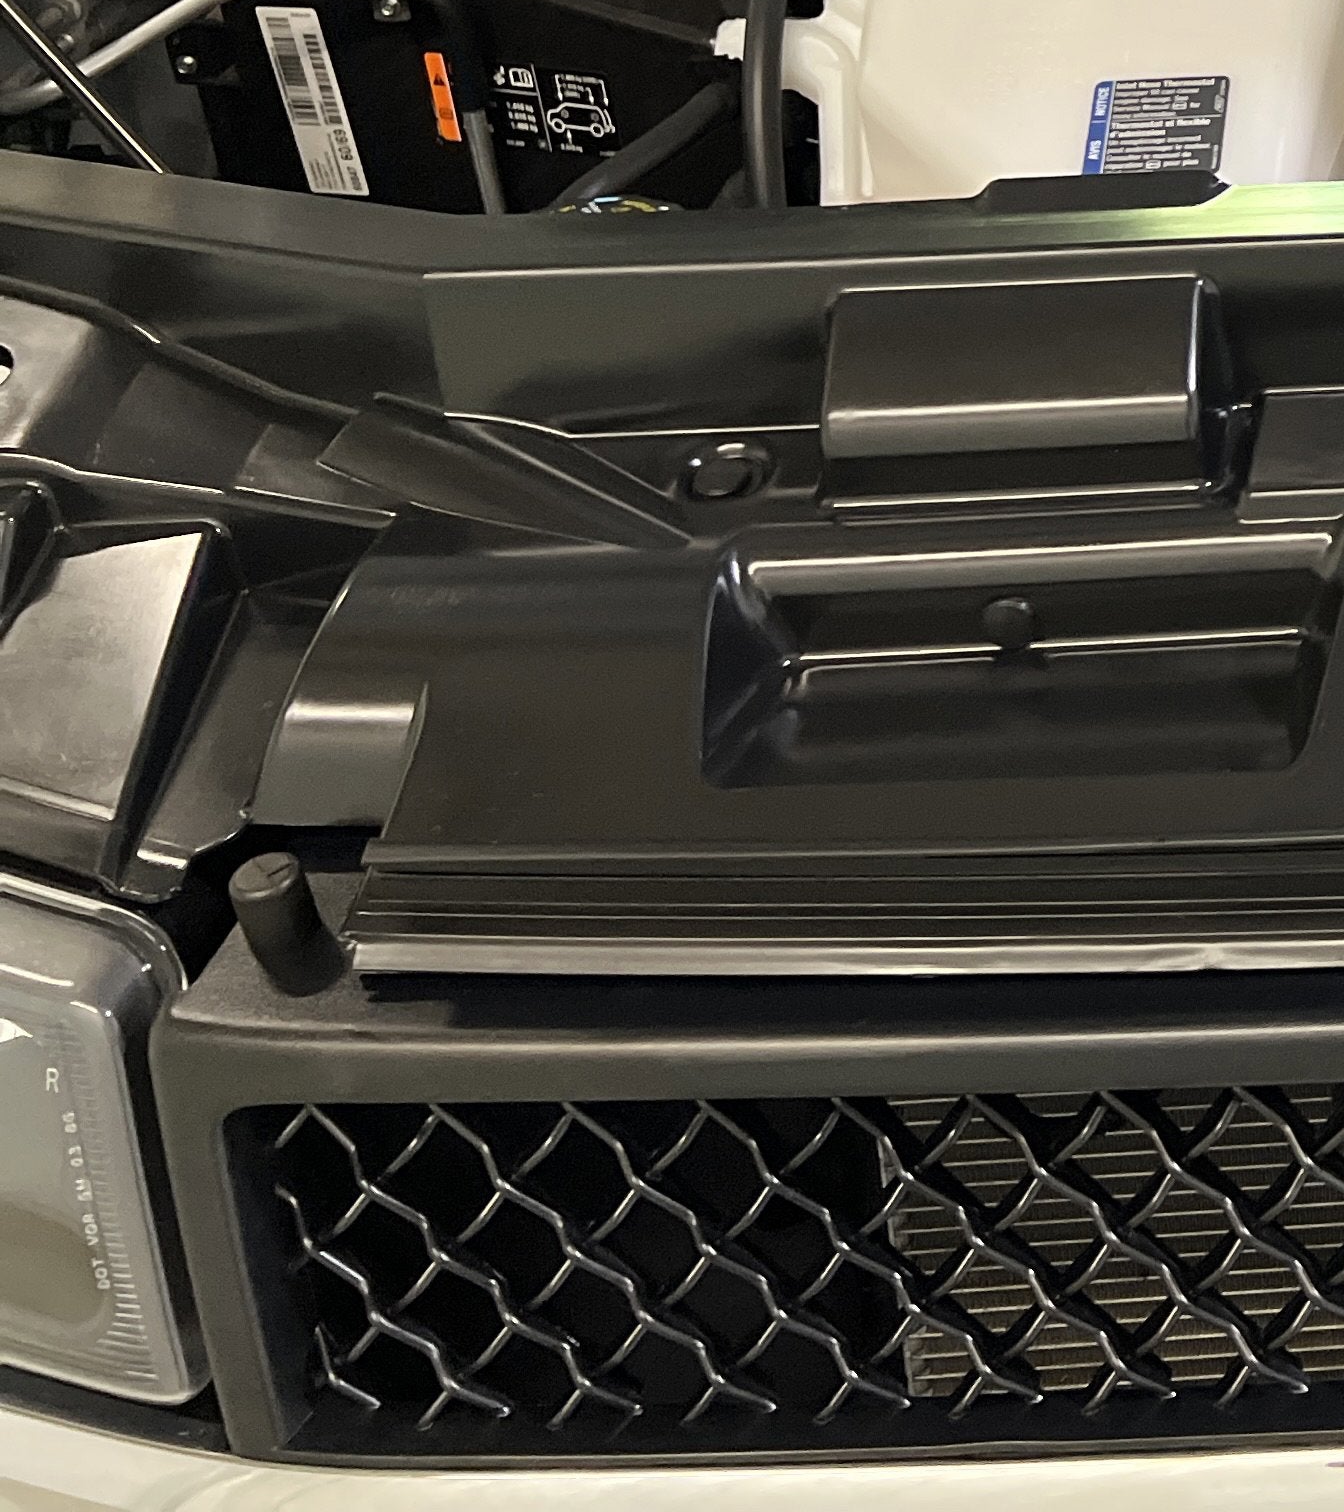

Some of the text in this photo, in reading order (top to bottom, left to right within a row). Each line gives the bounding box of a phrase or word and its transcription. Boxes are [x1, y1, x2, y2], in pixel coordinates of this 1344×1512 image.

[45, 1067, 60, 1093] R
[82, 1213, 99, 1246] VOR
[91, 1257, 111, 1289] DOT
